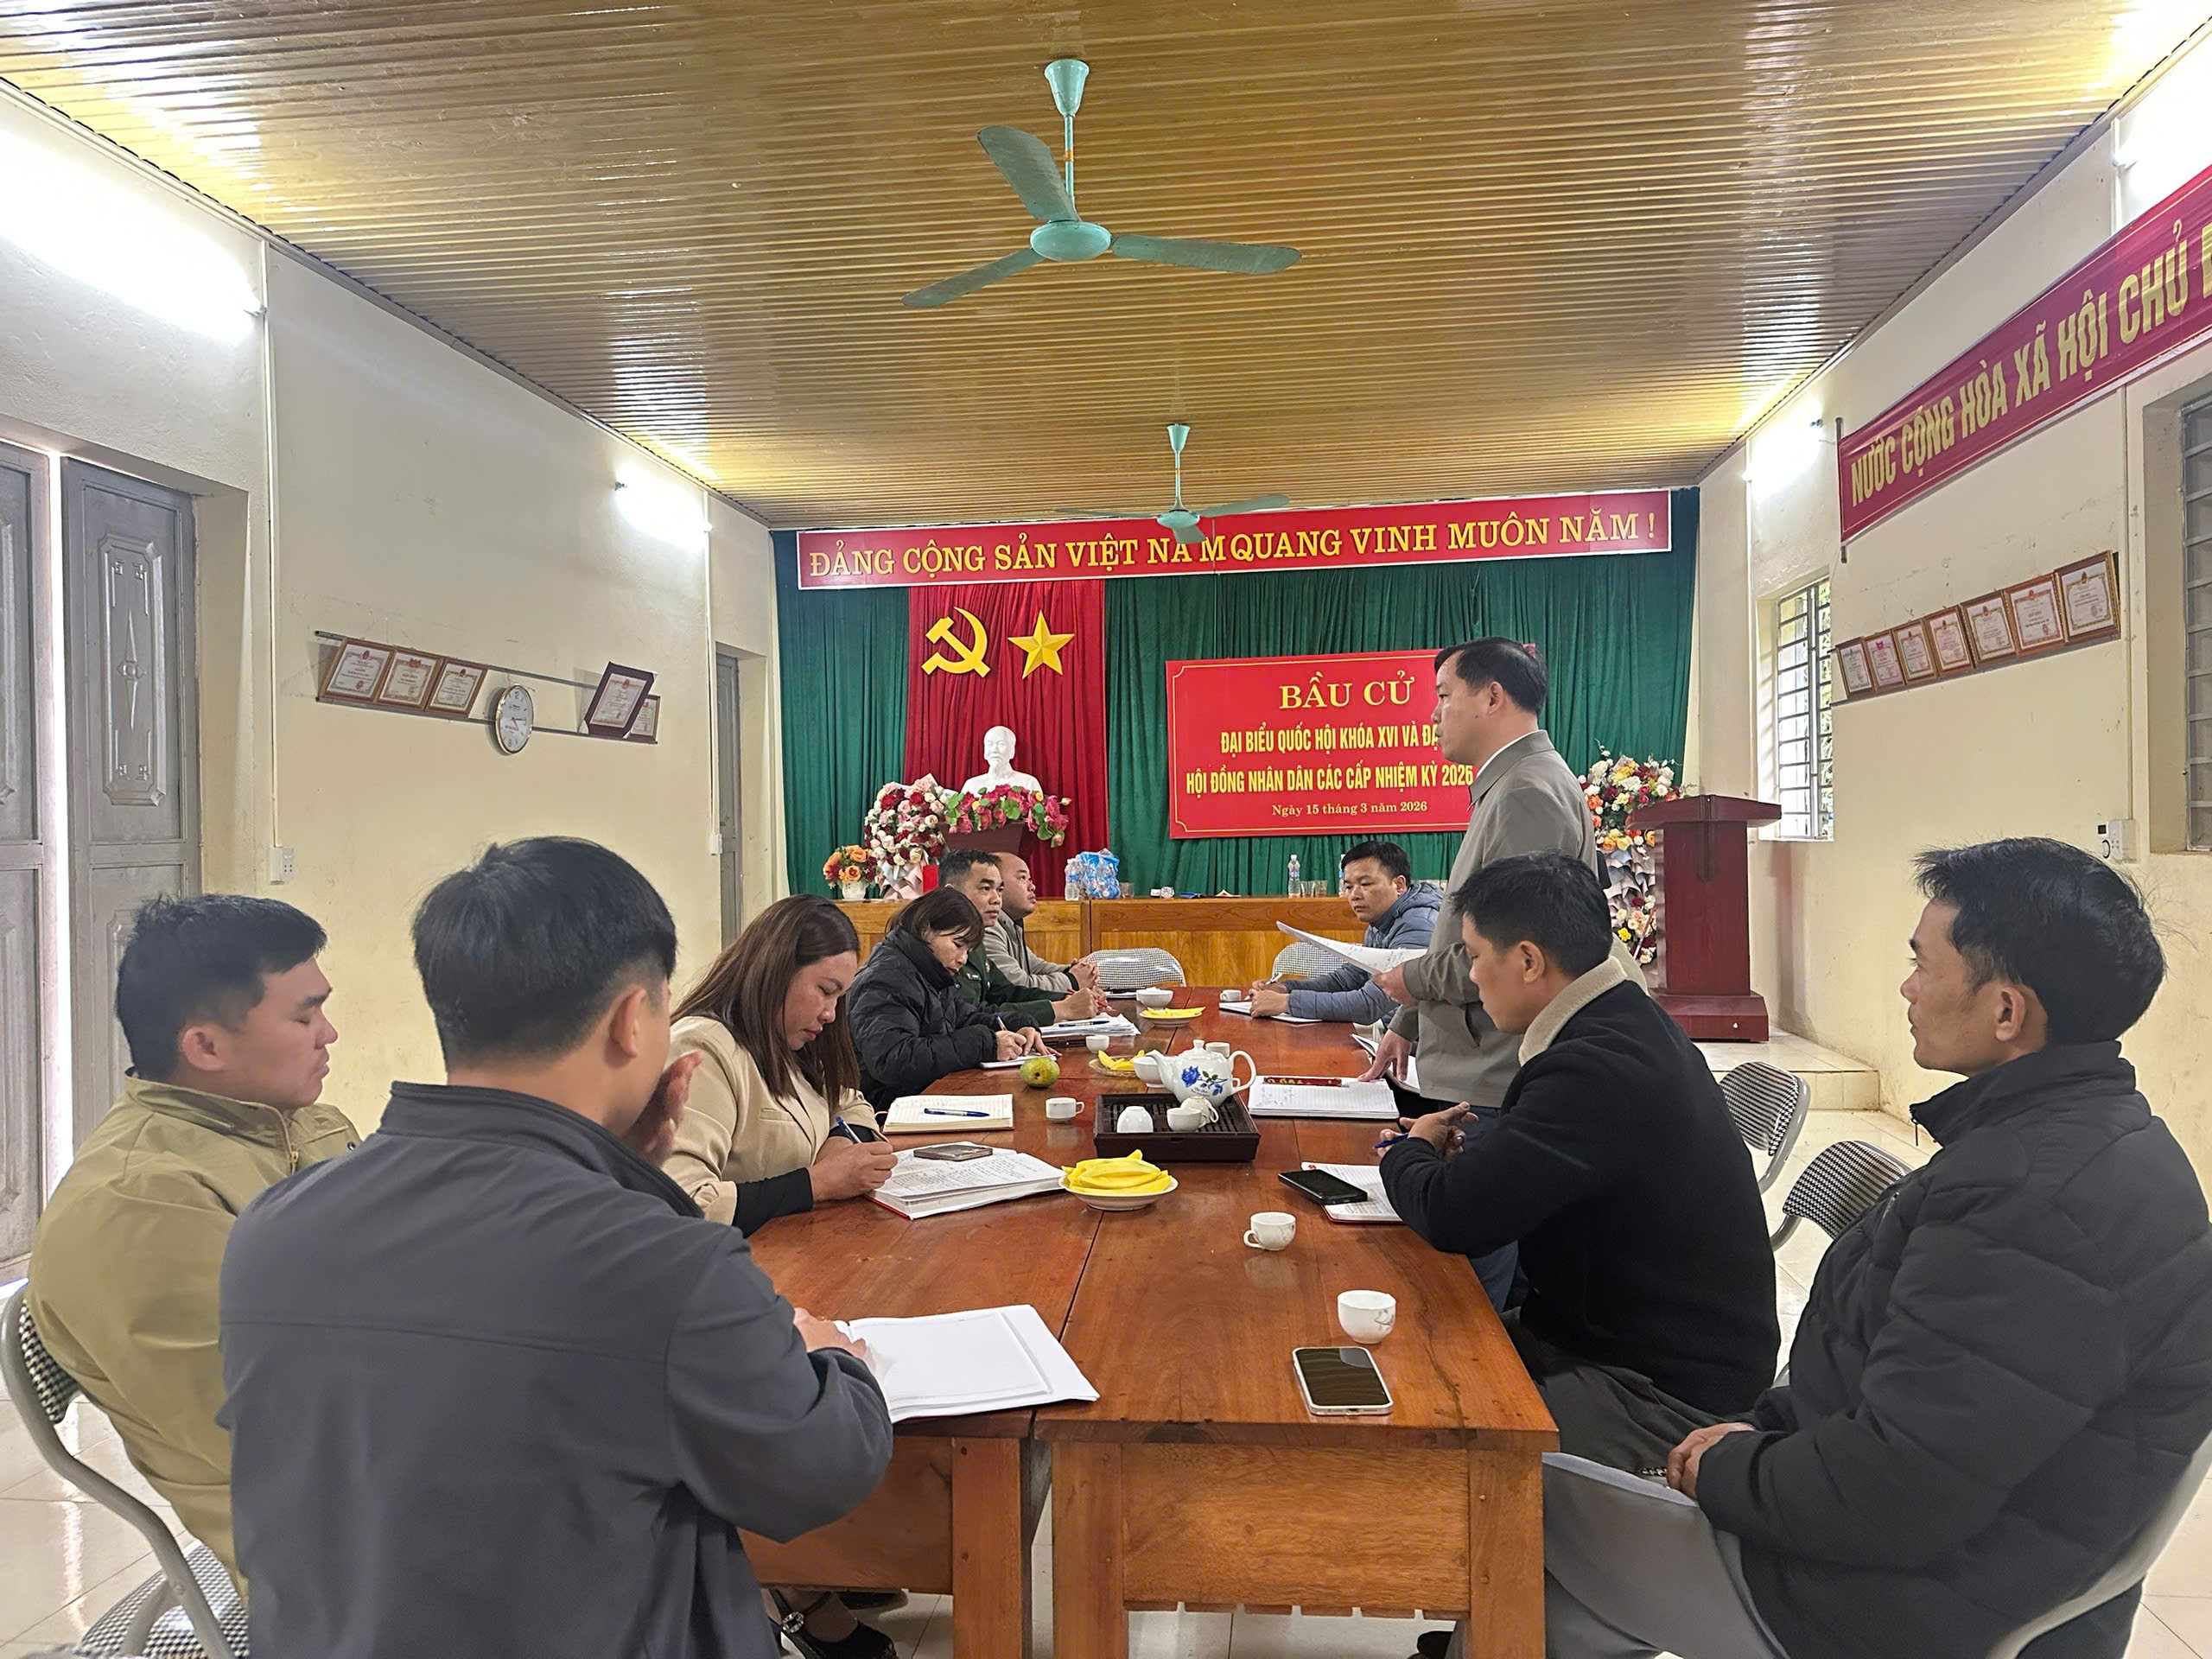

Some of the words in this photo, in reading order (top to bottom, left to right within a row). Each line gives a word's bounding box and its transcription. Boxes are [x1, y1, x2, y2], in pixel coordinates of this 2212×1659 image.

[1851, 434, 1897, 507] NƯỚC
[1901, 395, 1956, 477] CỘNG
[1959, 359, 2008, 438] HÒA
[2014, 320, 2050, 406] XÃ
[2057, 288, 2108, 382] HỘI
[2119, 218, 2189, 344] CHỦ
[810, 539, 895, 577] ĐẢNG
[903, 539, 987, 580] CỘNG
[995, 533, 1058, 571] SẢN
[1065, 533, 1138, 573] VIỆT
[1147, 534, 1227, 564] NAM
[1230, 530, 1343, 562] QUANG
[1349, 524, 1438, 555] VINH
[1447, 512, 1549, 550] MUÔN
[1559, 509, 1637, 543] NĂM
[1648, 512, 1656, 539] !
[1279, 671, 1354, 709] BẦU
[1363, 671, 1415, 706] CỬ
[1220, 731, 1243, 758] ĐẠI
[1245, 721, 1274, 753] BIỂU
[1277, 721, 1312, 753] QUỐC
[1314, 723, 1337, 755] HỘI
[1339, 721, 1375, 749] KHÓA
[1377, 725, 1399, 748] XVI
[1402, 720, 1420, 747] VÀ
[1421, 724, 1439, 752] ĐẠ
[1185, 767, 1207, 799] HỘI
[1210, 764, 1245, 793] ĐỒNG
[1248, 765, 1284, 793] NHÂN
[1287, 765, 1313, 792] DÂN
[1316, 764, 1343, 791] CÁC
[1345, 760, 1372, 790] CẤP
[1375, 760, 1418, 793] NHIỆM
[1421, 760, 1439, 787] KỲ
[1272, 804, 1303, 817] Ngày
[1306, 804, 1319, 815] 15
[1322, 802, 1358, 817] tháng
[1360, 803, 1368, 813] 3
[1370, 803, 1398, 814] năm
[1400, 800, 1428, 812] 2026
